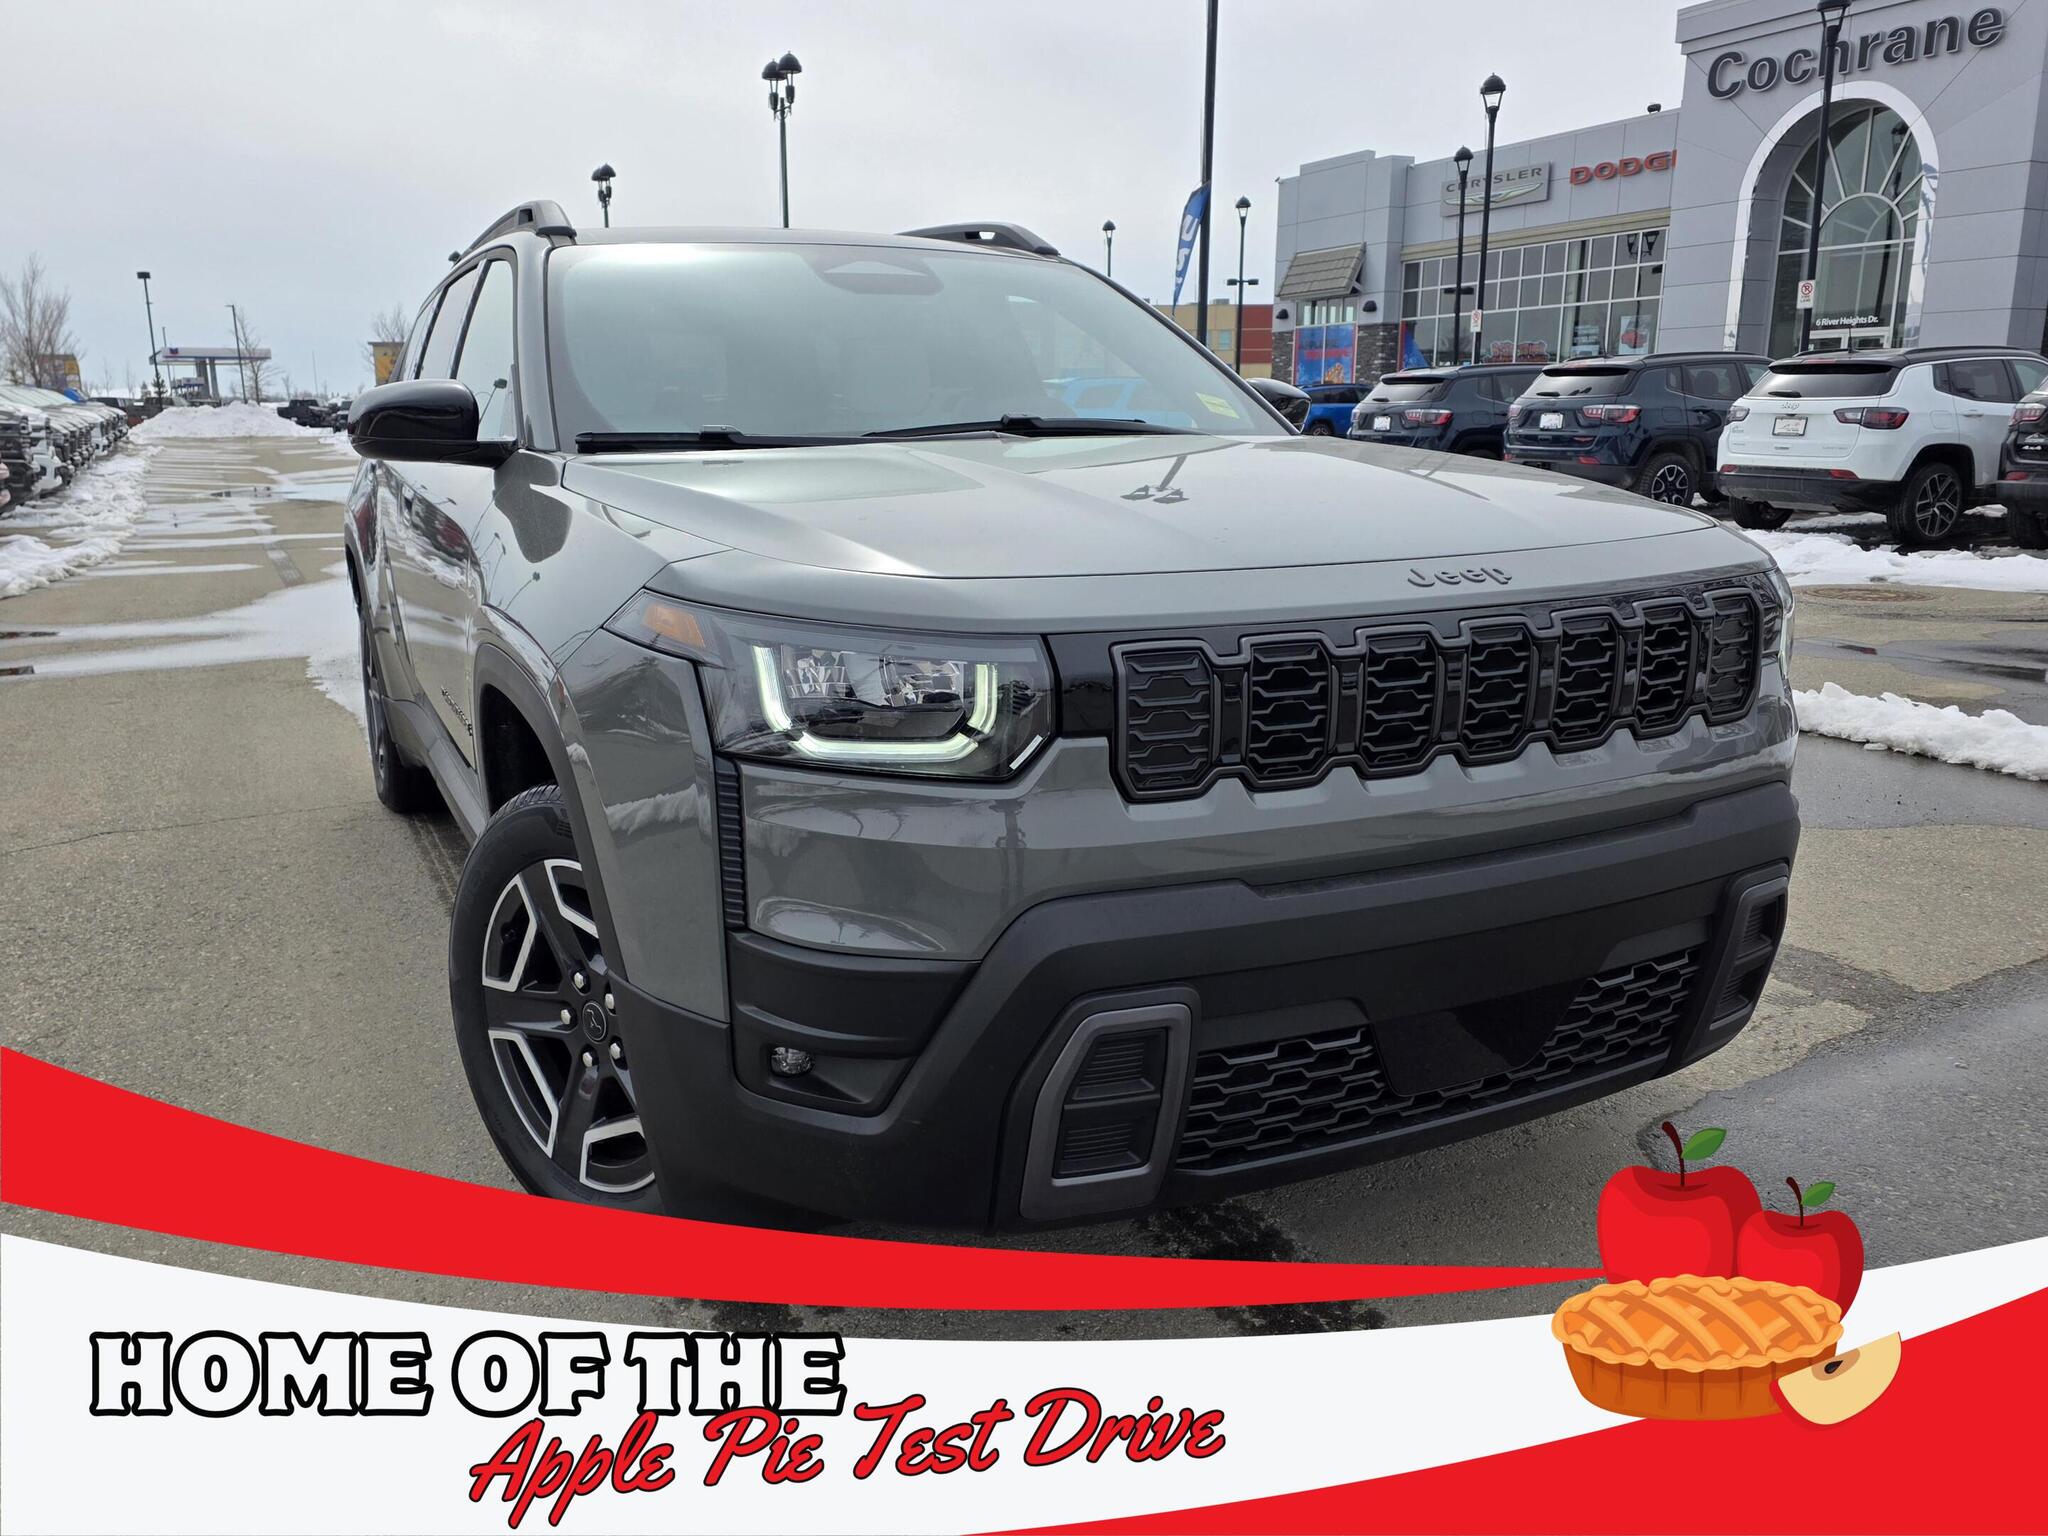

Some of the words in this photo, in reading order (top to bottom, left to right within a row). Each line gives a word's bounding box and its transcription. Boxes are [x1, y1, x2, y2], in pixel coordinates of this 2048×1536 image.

[1707, 6, 2005, 99] Cochrane
[1446, 167, 1543, 193] CRSLER
[1815, 319, 1821, 327] 6
[1822, 317, 1840, 326] River
[1840, 315, 1867, 326] Heights
[1407, 567, 1513, 588] Jeep
